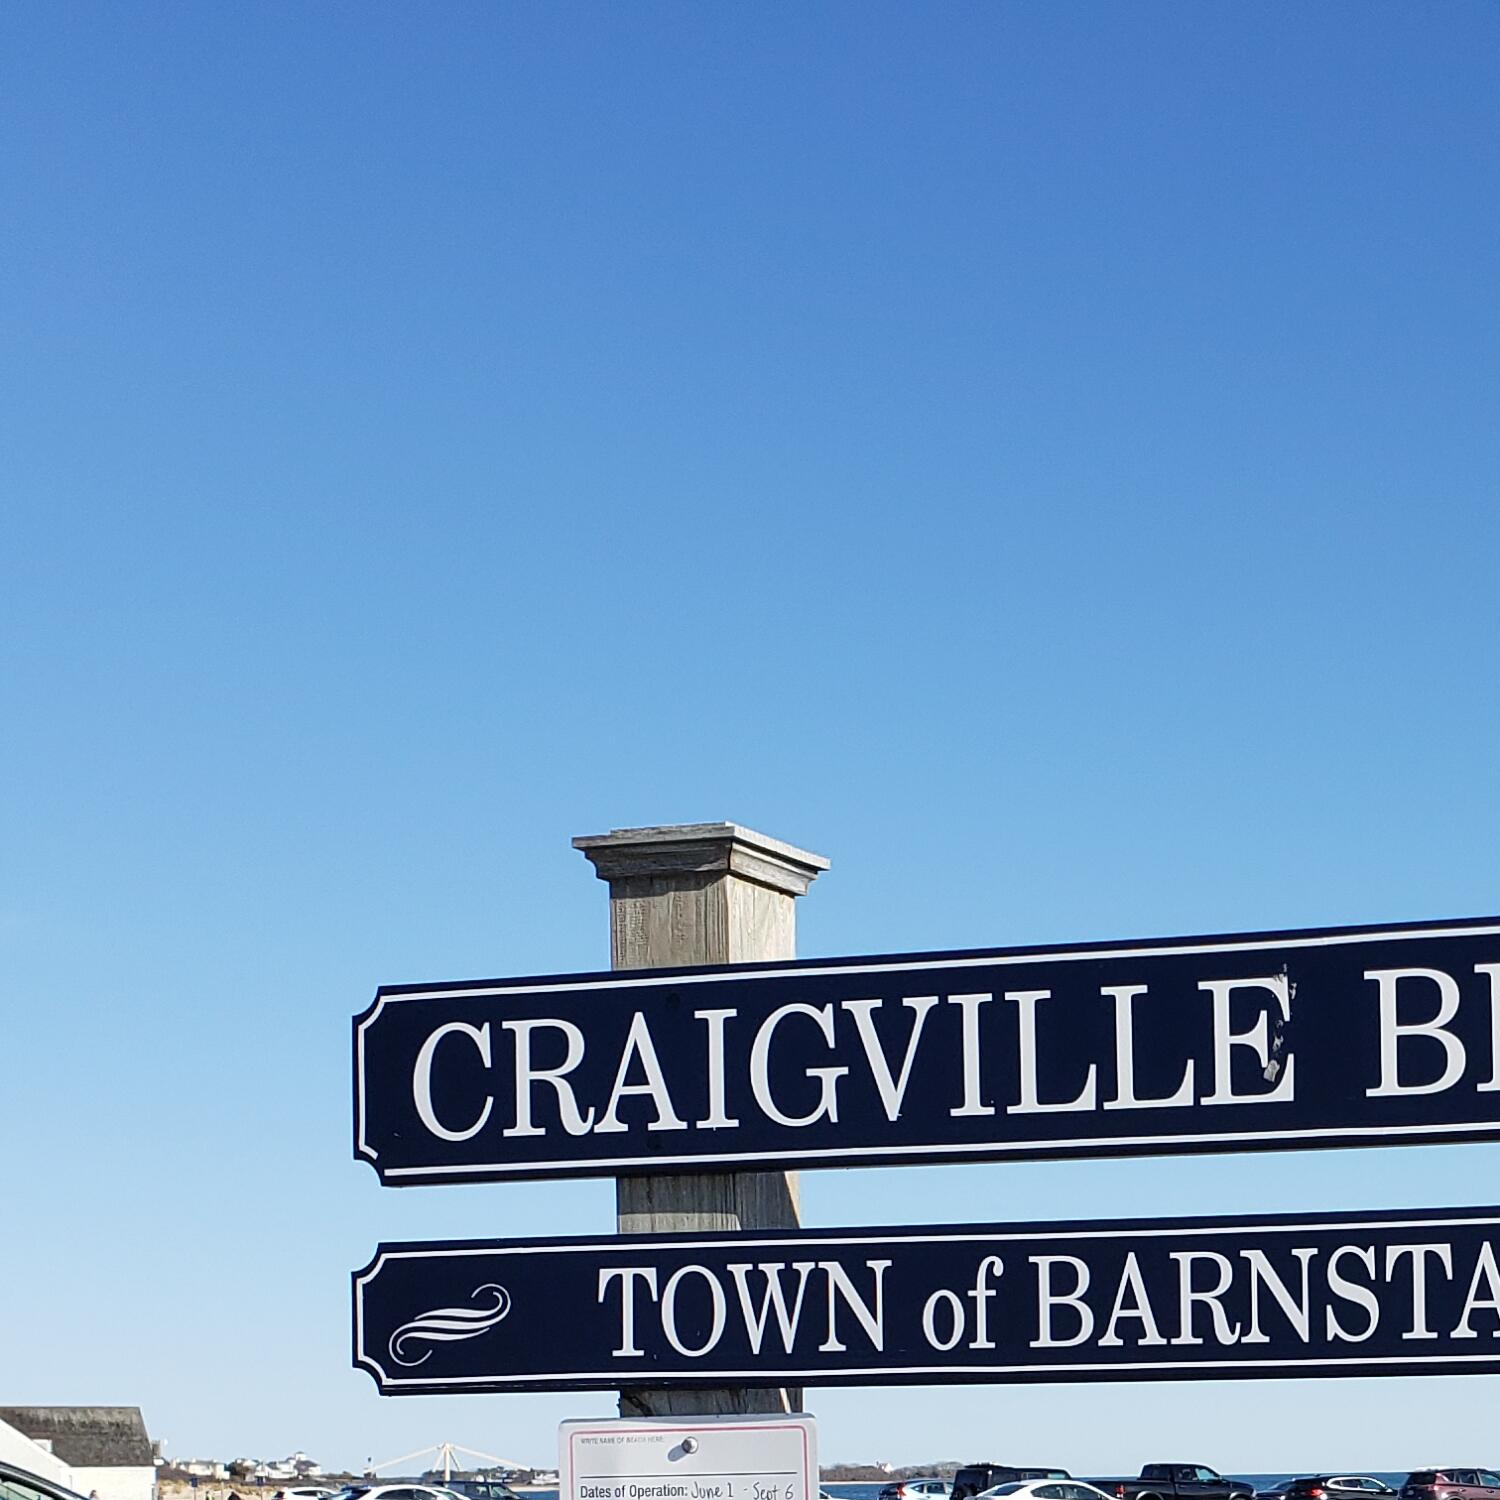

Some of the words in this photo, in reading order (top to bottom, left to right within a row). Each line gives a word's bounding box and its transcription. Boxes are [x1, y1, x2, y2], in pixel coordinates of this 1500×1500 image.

[411, 974, 1296, 1142] CRAIGVILLE
[599, 1260, 892, 1356] TOWN
[923, 1256, 1003, 1350] of
[581, 1486, 611, 1498] Dates
[615, 1485, 625, 1497] of
[630, 1484, 687, 1500] Operation:
[691, 1481, 723, 1499] June
[728, 1482, 734, 1497] 1
[785, 1484, 793, 1500] 6
